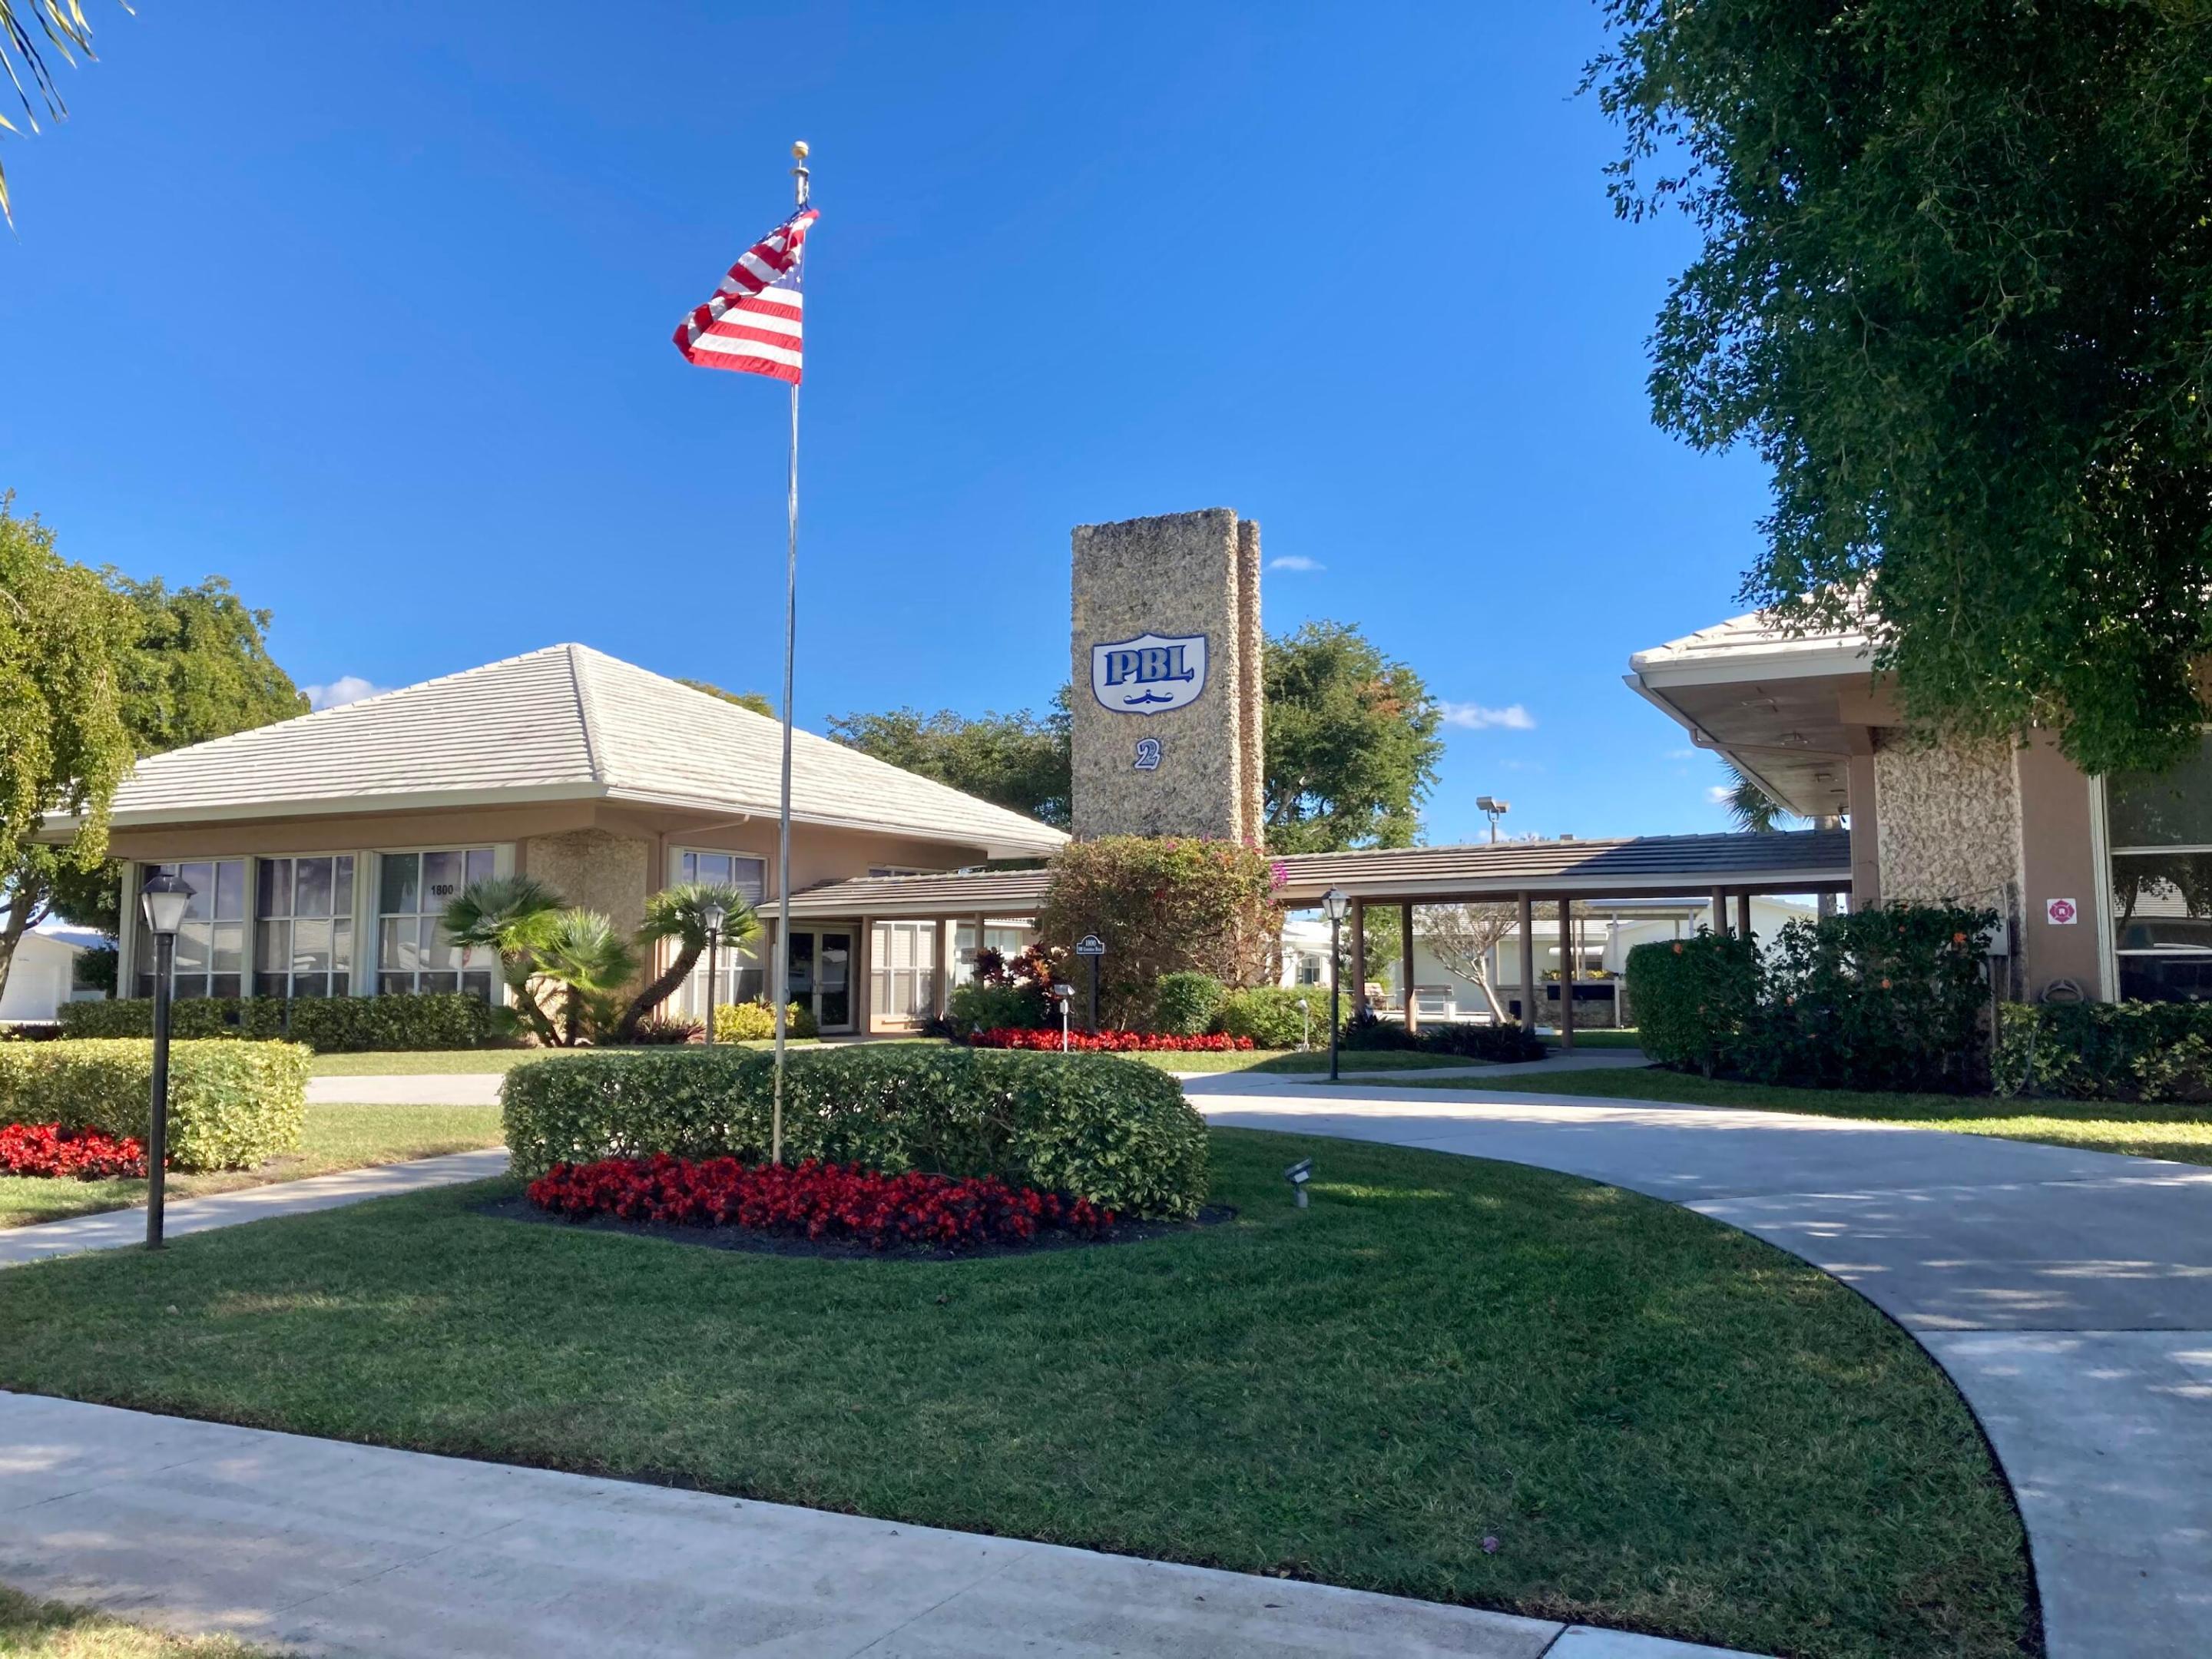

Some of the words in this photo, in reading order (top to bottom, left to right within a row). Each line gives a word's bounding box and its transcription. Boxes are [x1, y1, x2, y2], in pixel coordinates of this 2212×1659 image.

[1104, 644, 1194, 686] PBL
[1134, 737, 1161, 770] 2
[431, 885, 454, 896] 1800
